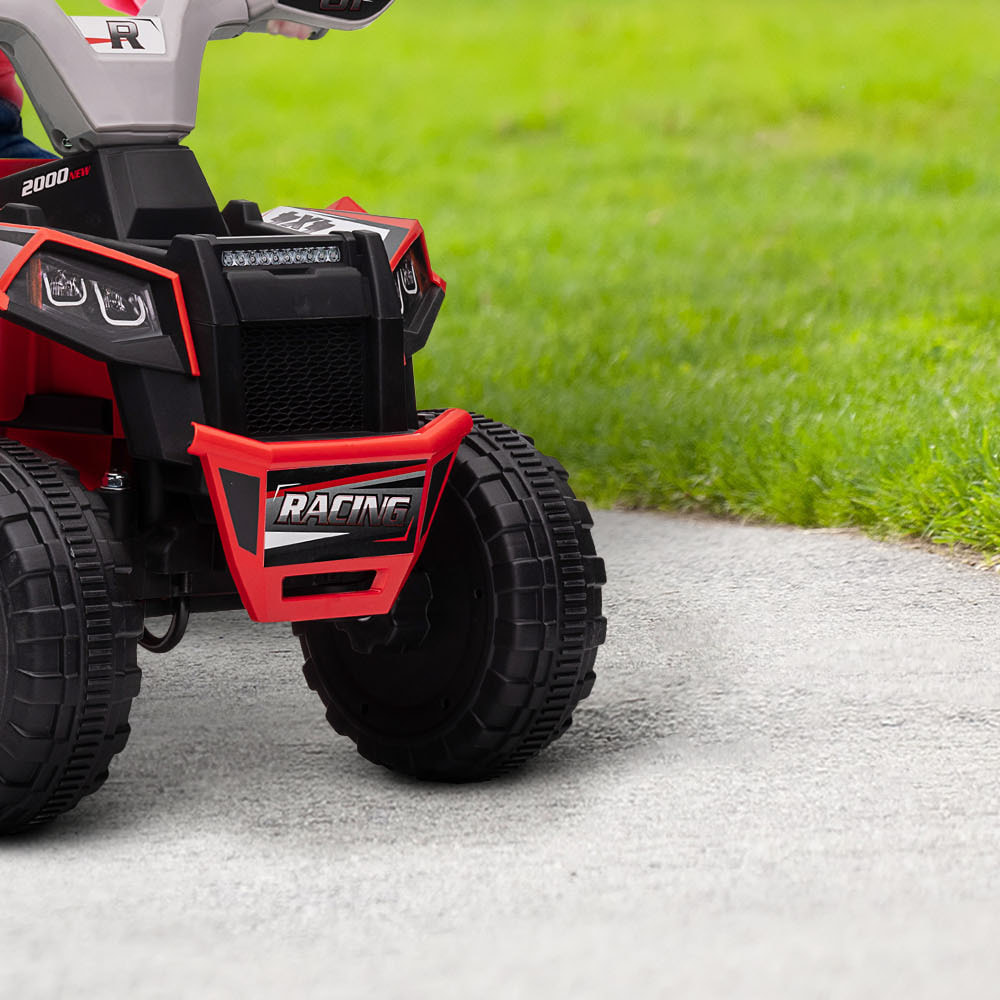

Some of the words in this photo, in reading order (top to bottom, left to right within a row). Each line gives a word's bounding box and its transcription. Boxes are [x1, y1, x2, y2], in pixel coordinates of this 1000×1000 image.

[106, 20, 145, 50] R
[21, 167, 69, 197] 2000
[69, 164, 92, 181] NEW
[274, 491, 412, 527] RACING
